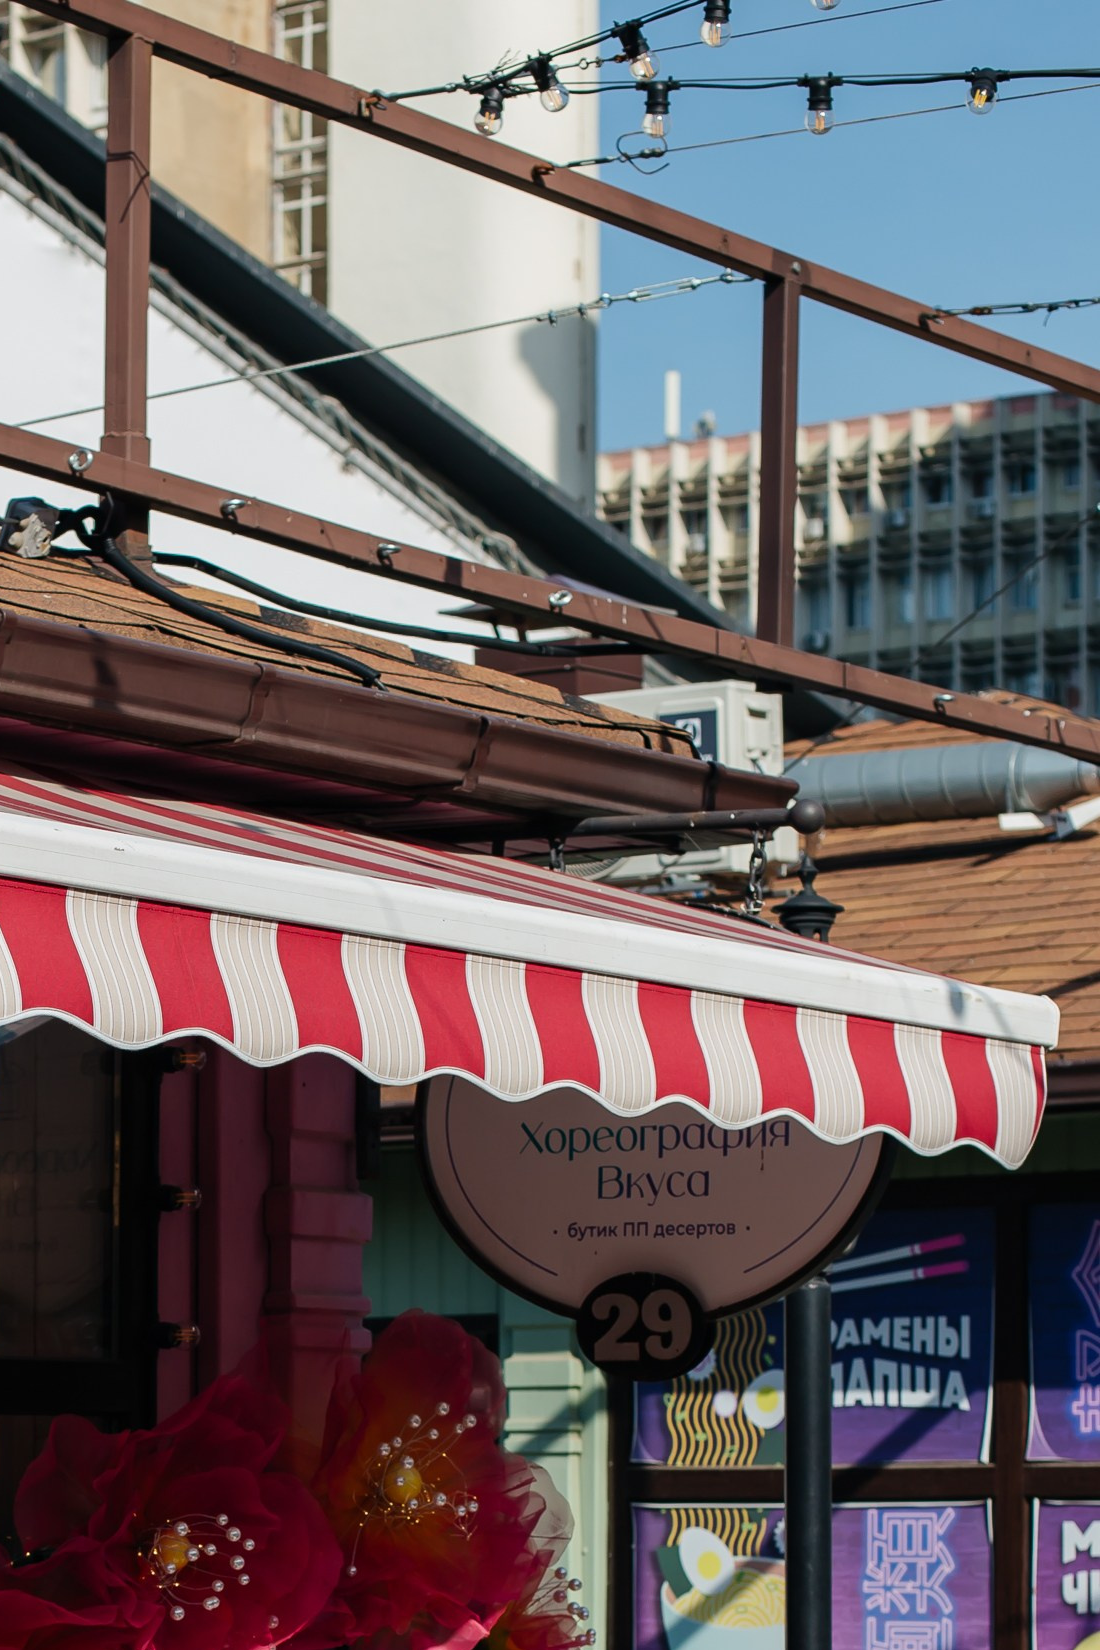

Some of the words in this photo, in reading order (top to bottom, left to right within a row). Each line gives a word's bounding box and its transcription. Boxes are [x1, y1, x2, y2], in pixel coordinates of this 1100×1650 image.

[519, 1120, 790, 1161] Хореография
[597, 1165, 710, 1207] Вкуса
[567, 1222, 618, 1242] бутик
[623, 1222, 649, 1237] ПП
[654, 1222, 737, 1240] десертов
[591, 1288, 693, 1362] 29
